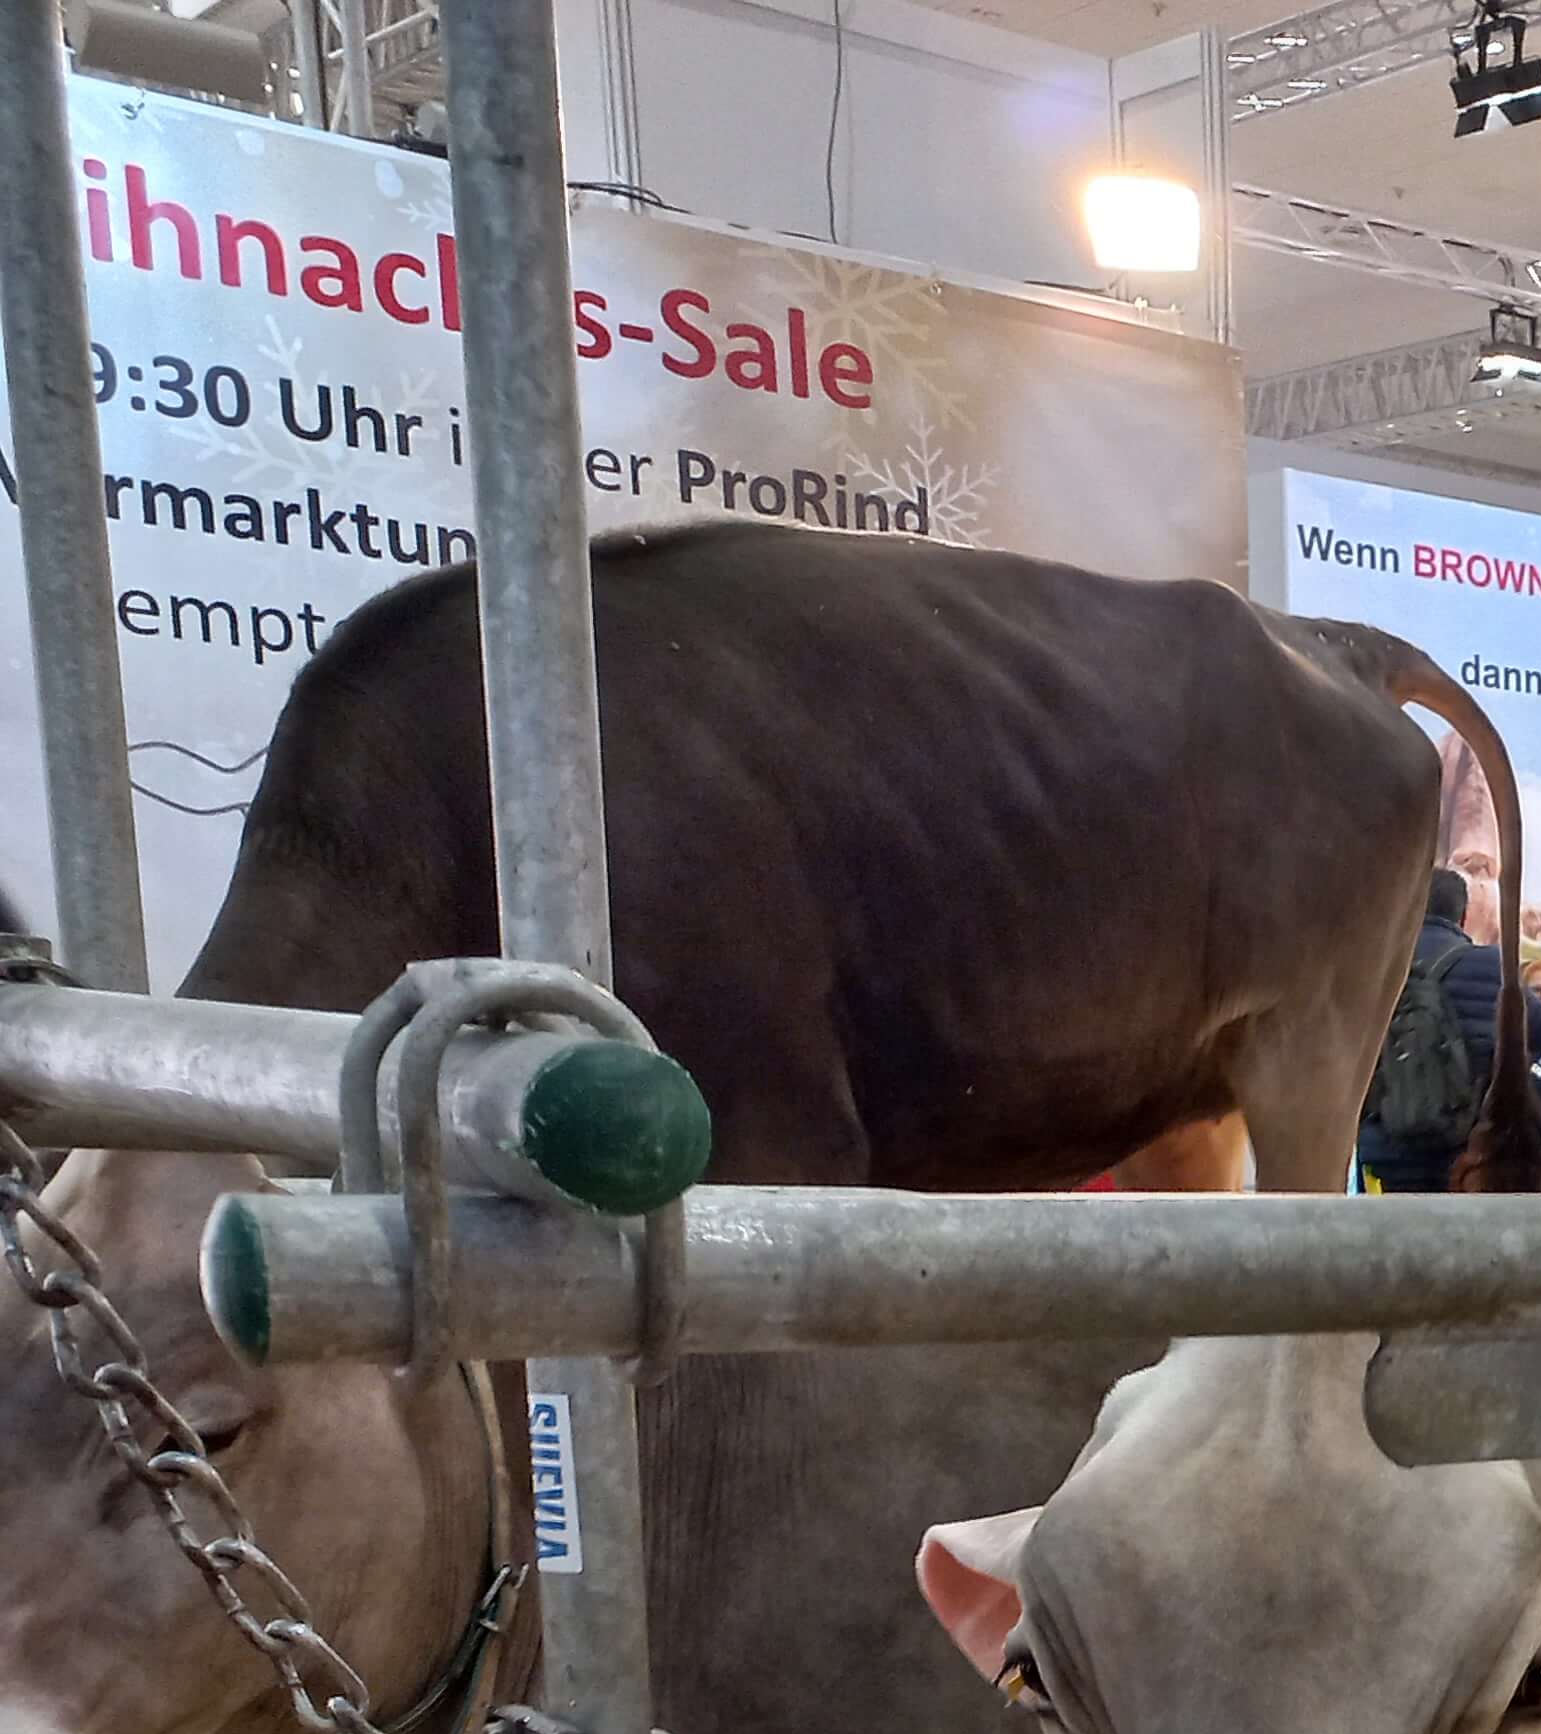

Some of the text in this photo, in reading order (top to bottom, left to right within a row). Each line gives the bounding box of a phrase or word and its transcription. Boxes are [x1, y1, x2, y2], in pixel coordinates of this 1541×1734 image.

[279, 376, 422, 457] Uhr
[585, 446, 653, 497] er
[677, 448, 929, 536] ProRind
[1297, 523, 1400, 573] Wenn
[530, 1402, 569, 1559] SUEVIA
